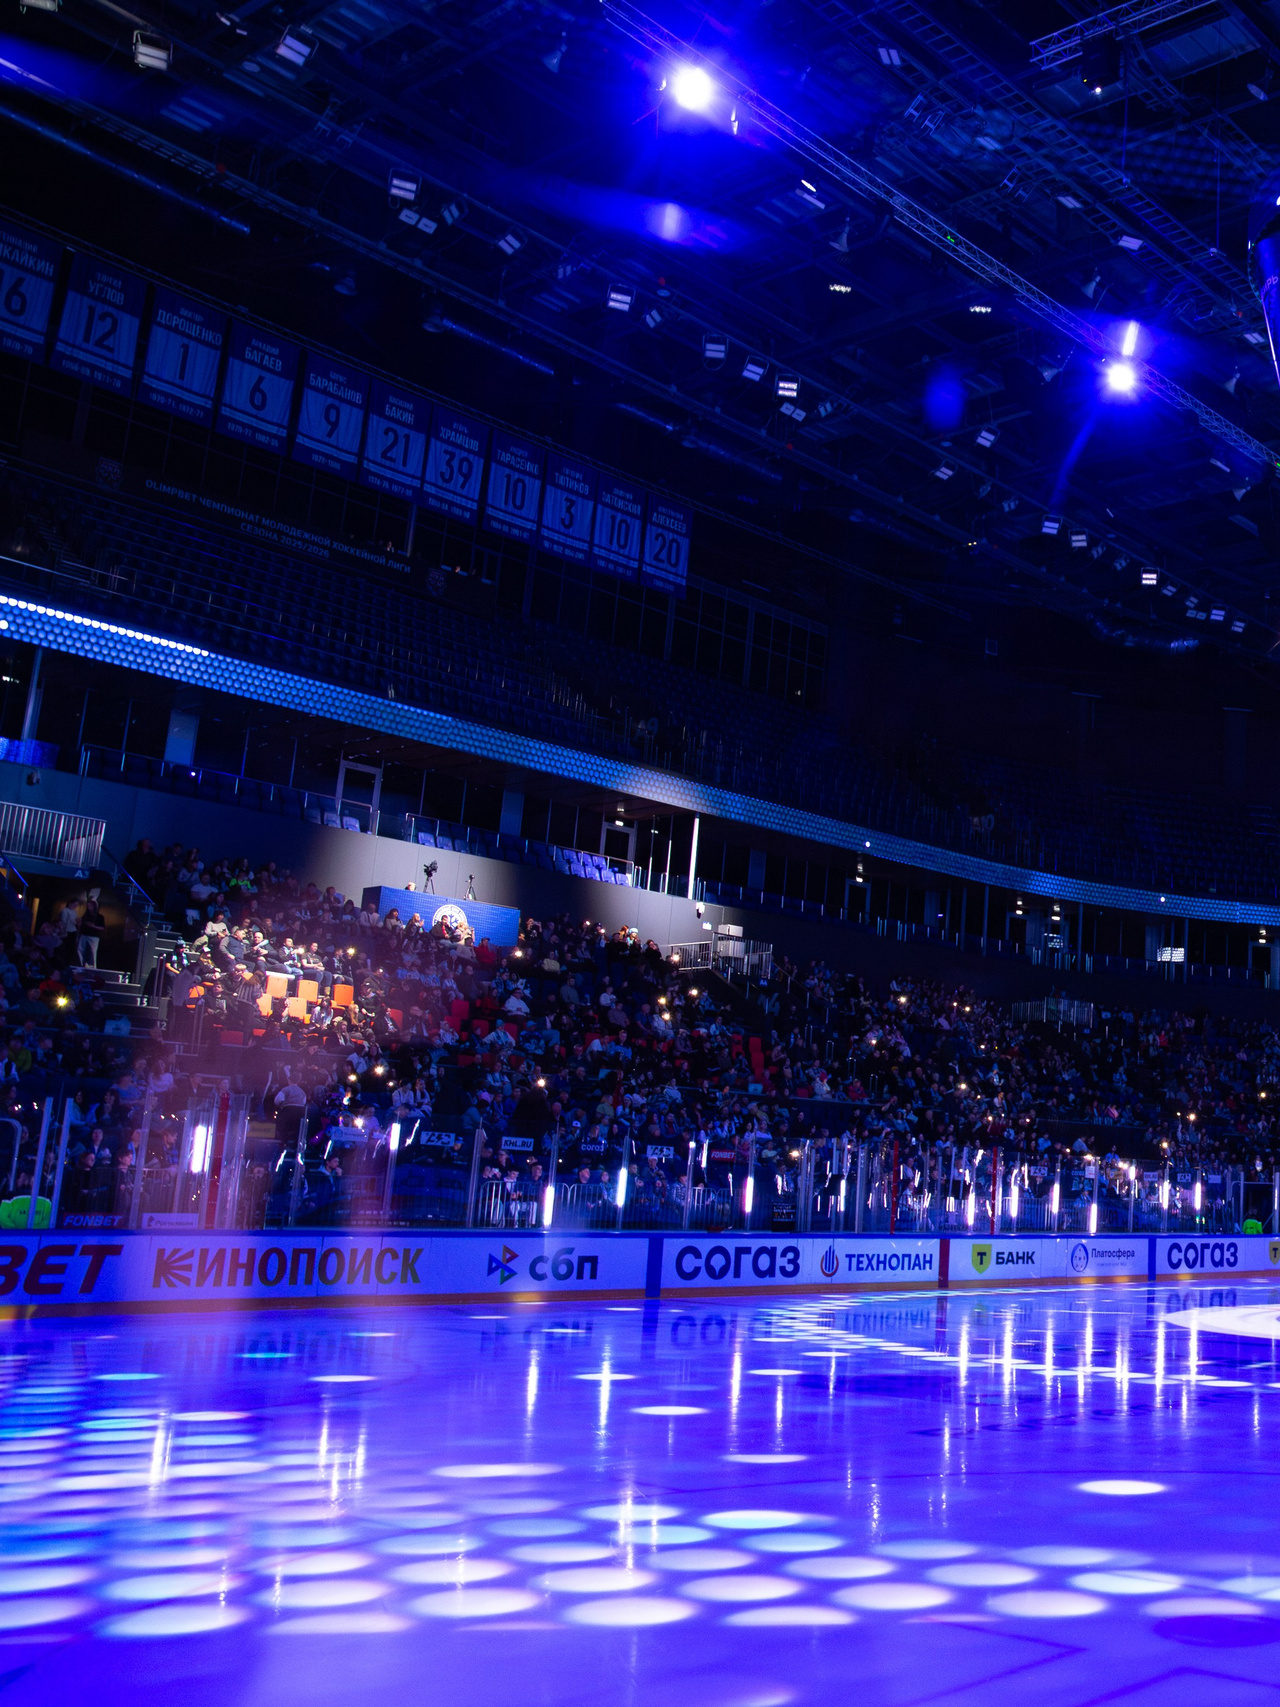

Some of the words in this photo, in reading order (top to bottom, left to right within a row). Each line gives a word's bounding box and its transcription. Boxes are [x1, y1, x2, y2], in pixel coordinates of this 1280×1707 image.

[0, 243, 54, 277] КАЙКИН
[88, 280, 125, 305] УГЛОВ
[83, 304, 118, 353] 12
[157, 309, 222, 346] ДОРОЩЕНКО
[178, 343, 190, 381] 1
[245, 347, 282, 372] БАГАЕВ
[249, 375, 267, 411] 6
[309, 373, 362, 405] БАРАБАНОВ
[324, 403, 340, 439] 9
[385, 404, 415, 425] БАКИН
[381, 427, 410, 468] 21
[440, 426, 479, 452] ХРАМЦОВ
[440, 449, 473, 490] 39
[497, 449, 540, 475] ТАРАСЕНКО
[504, 474, 526, 511] 10
[554, 472, 589, 495] ТЮТИКОВ
[145, 479, 198, 503] OLIMPBET
[199, 496, 260, 524] ЧЕМПИОНАТ
[262, 518, 331, 548] МОЛОДЕЖНОЙ
[332, 541, 386, 569] ХОККЕЙНОЙ
[387, 558, 411, 574] ЛИГИ
[561, 497, 576, 529] 3
[652, 512, 686, 533] АЛЕКСЕЕВ
[240, 522, 278, 542] СЕЗОНА
[280, 536, 330, 558] 2025/2026
[609, 514, 630, 549] 10
[653, 532, 680, 568] 20
[503, 1139, 532, 1149] KHL.RU
[711, 1150, 736, 1159] FONBET
[63, 1214, 123, 1227] FONBET
[153, 1247, 423, 1289] КИНОПОИСК
[845, 1253, 933, 1271] ТЕХНОПАН
[995, 1251, 1036, 1266] БАНК
[1091, 1248, 1135, 1260] Платосфера
